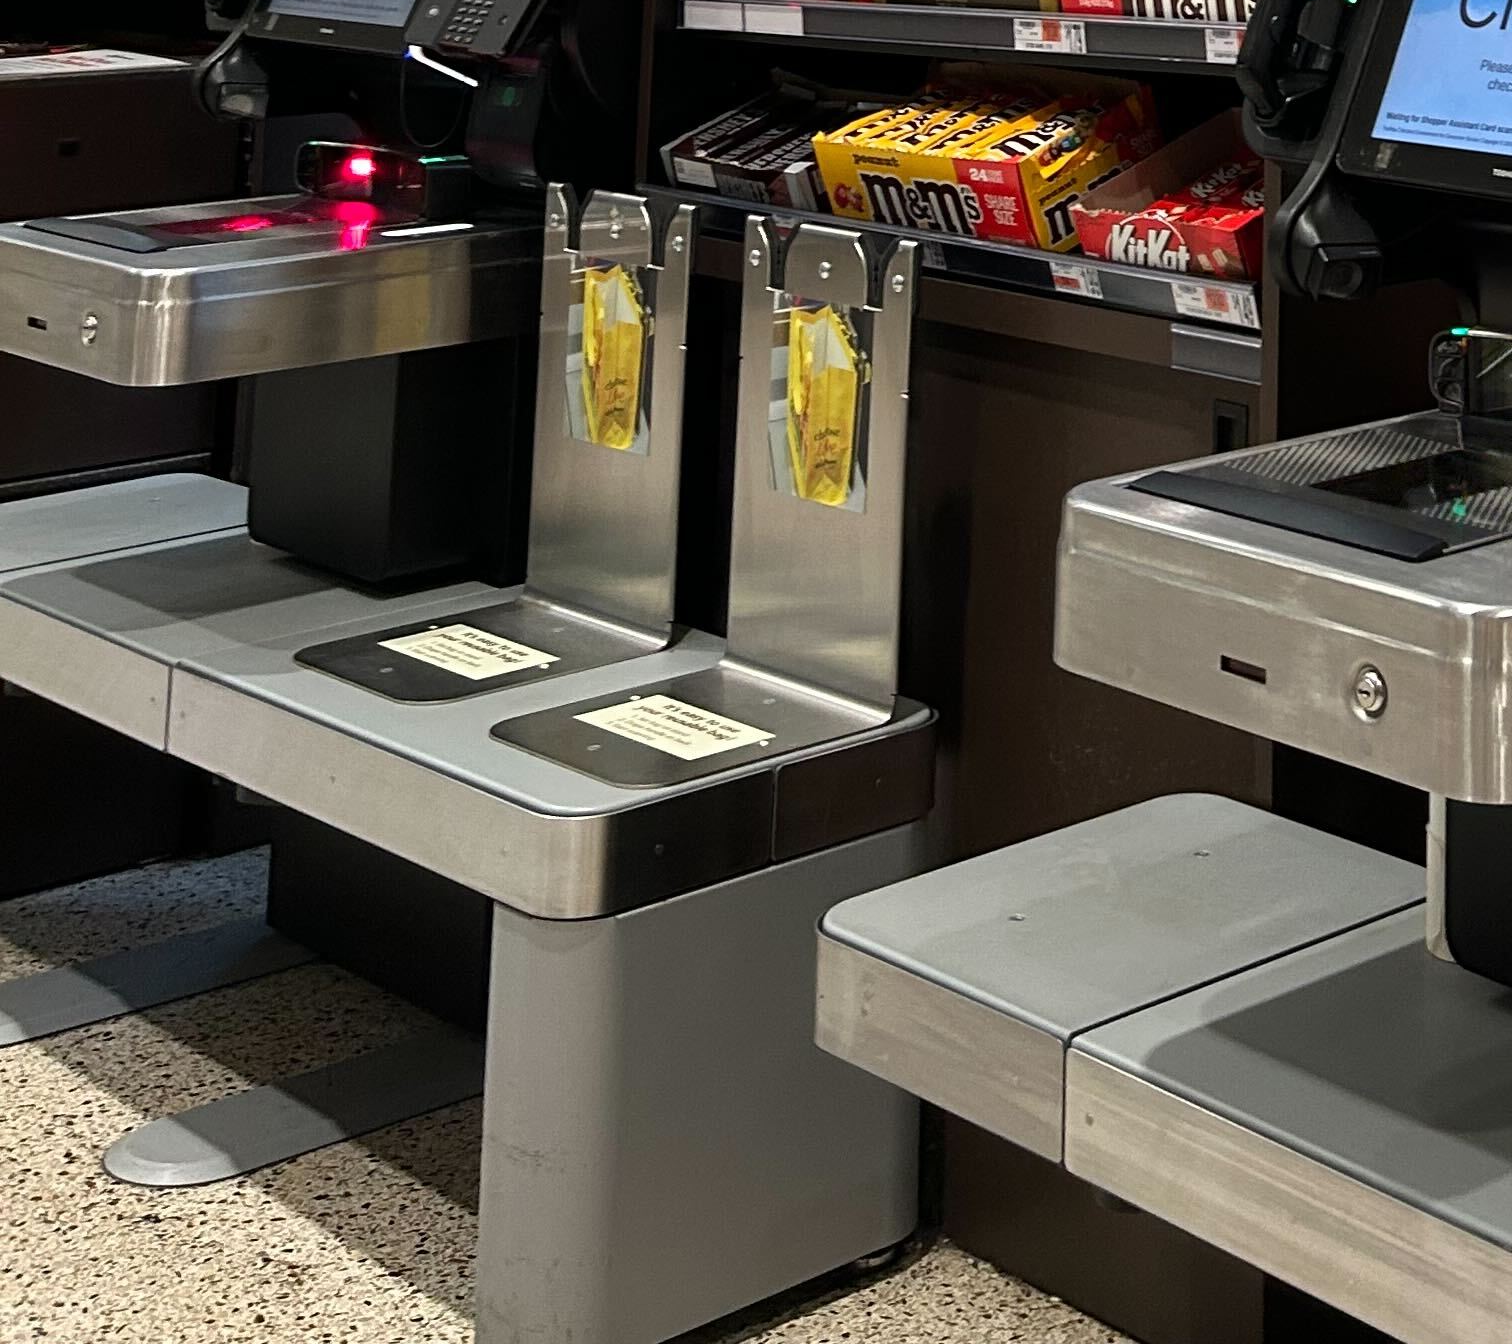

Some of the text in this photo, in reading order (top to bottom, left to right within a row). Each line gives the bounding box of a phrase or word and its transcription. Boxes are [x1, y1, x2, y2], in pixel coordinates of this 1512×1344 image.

[851, 152, 899, 167] peanut
[968, 167, 988, 182] 24
[984, 193, 1018, 211] SHARE
[994, 209, 1018, 227] SIZE
[1110, 224, 1191, 273] KitKat
